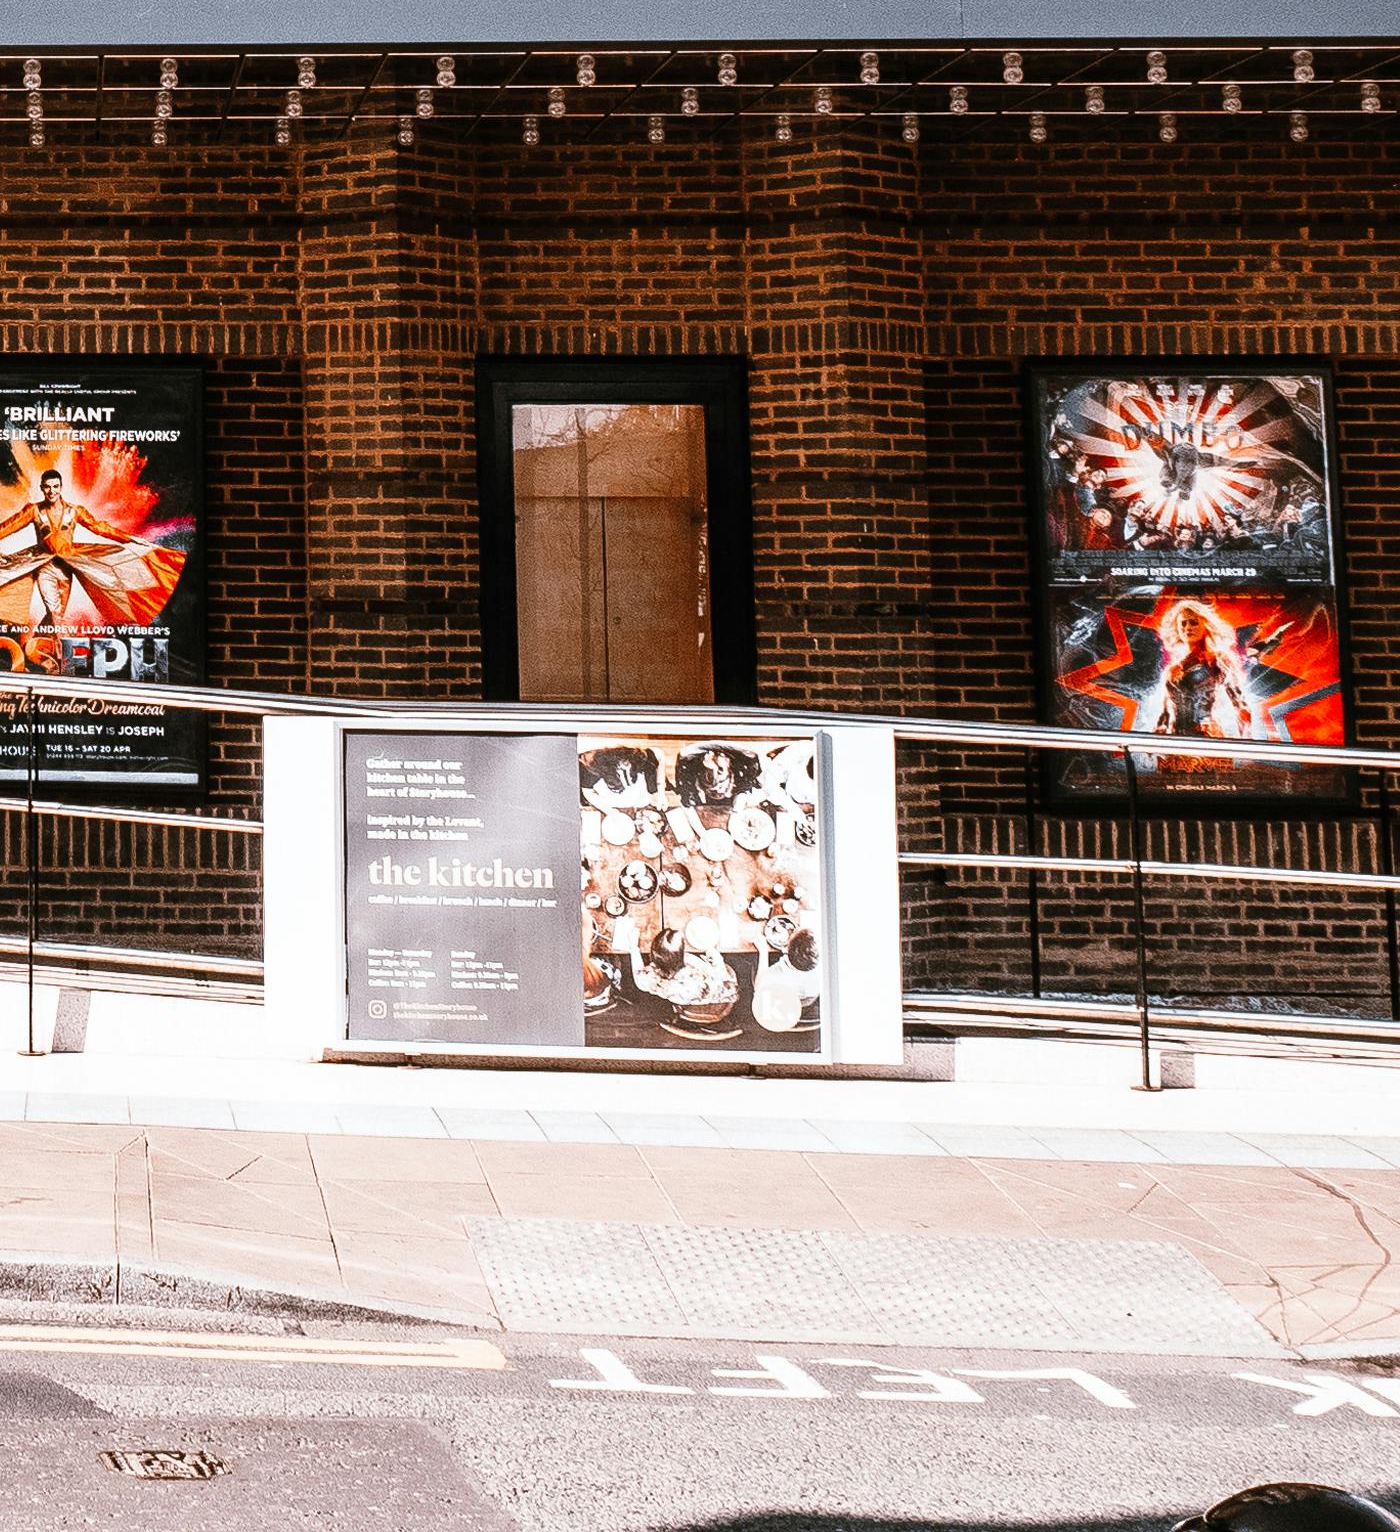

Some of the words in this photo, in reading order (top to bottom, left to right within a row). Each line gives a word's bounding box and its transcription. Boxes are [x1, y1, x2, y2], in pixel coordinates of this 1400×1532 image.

[12, 429, 37, 440] LIKE
[39, 429, 107, 442] GLITTERING
[32, 625, 78, 634] ANDREW
[81, 626, 114, 635] LLOYD
[87, 698, 165, 716] Dreamcoat
[49, 724, 103, 735] HENSLEY
[106, 726, 115, 735] IS
[118, 725, 165, 736] JOSEPH
[46, 744, 62, 752] TUE
[82, 745, 98, 753] SAT
[114, 745, 131, 753] APR
[368, 856, 421, 886] the
[428, 857, 554, 889] kitchen
[548, 1348, 1137, 1410] LEFT
